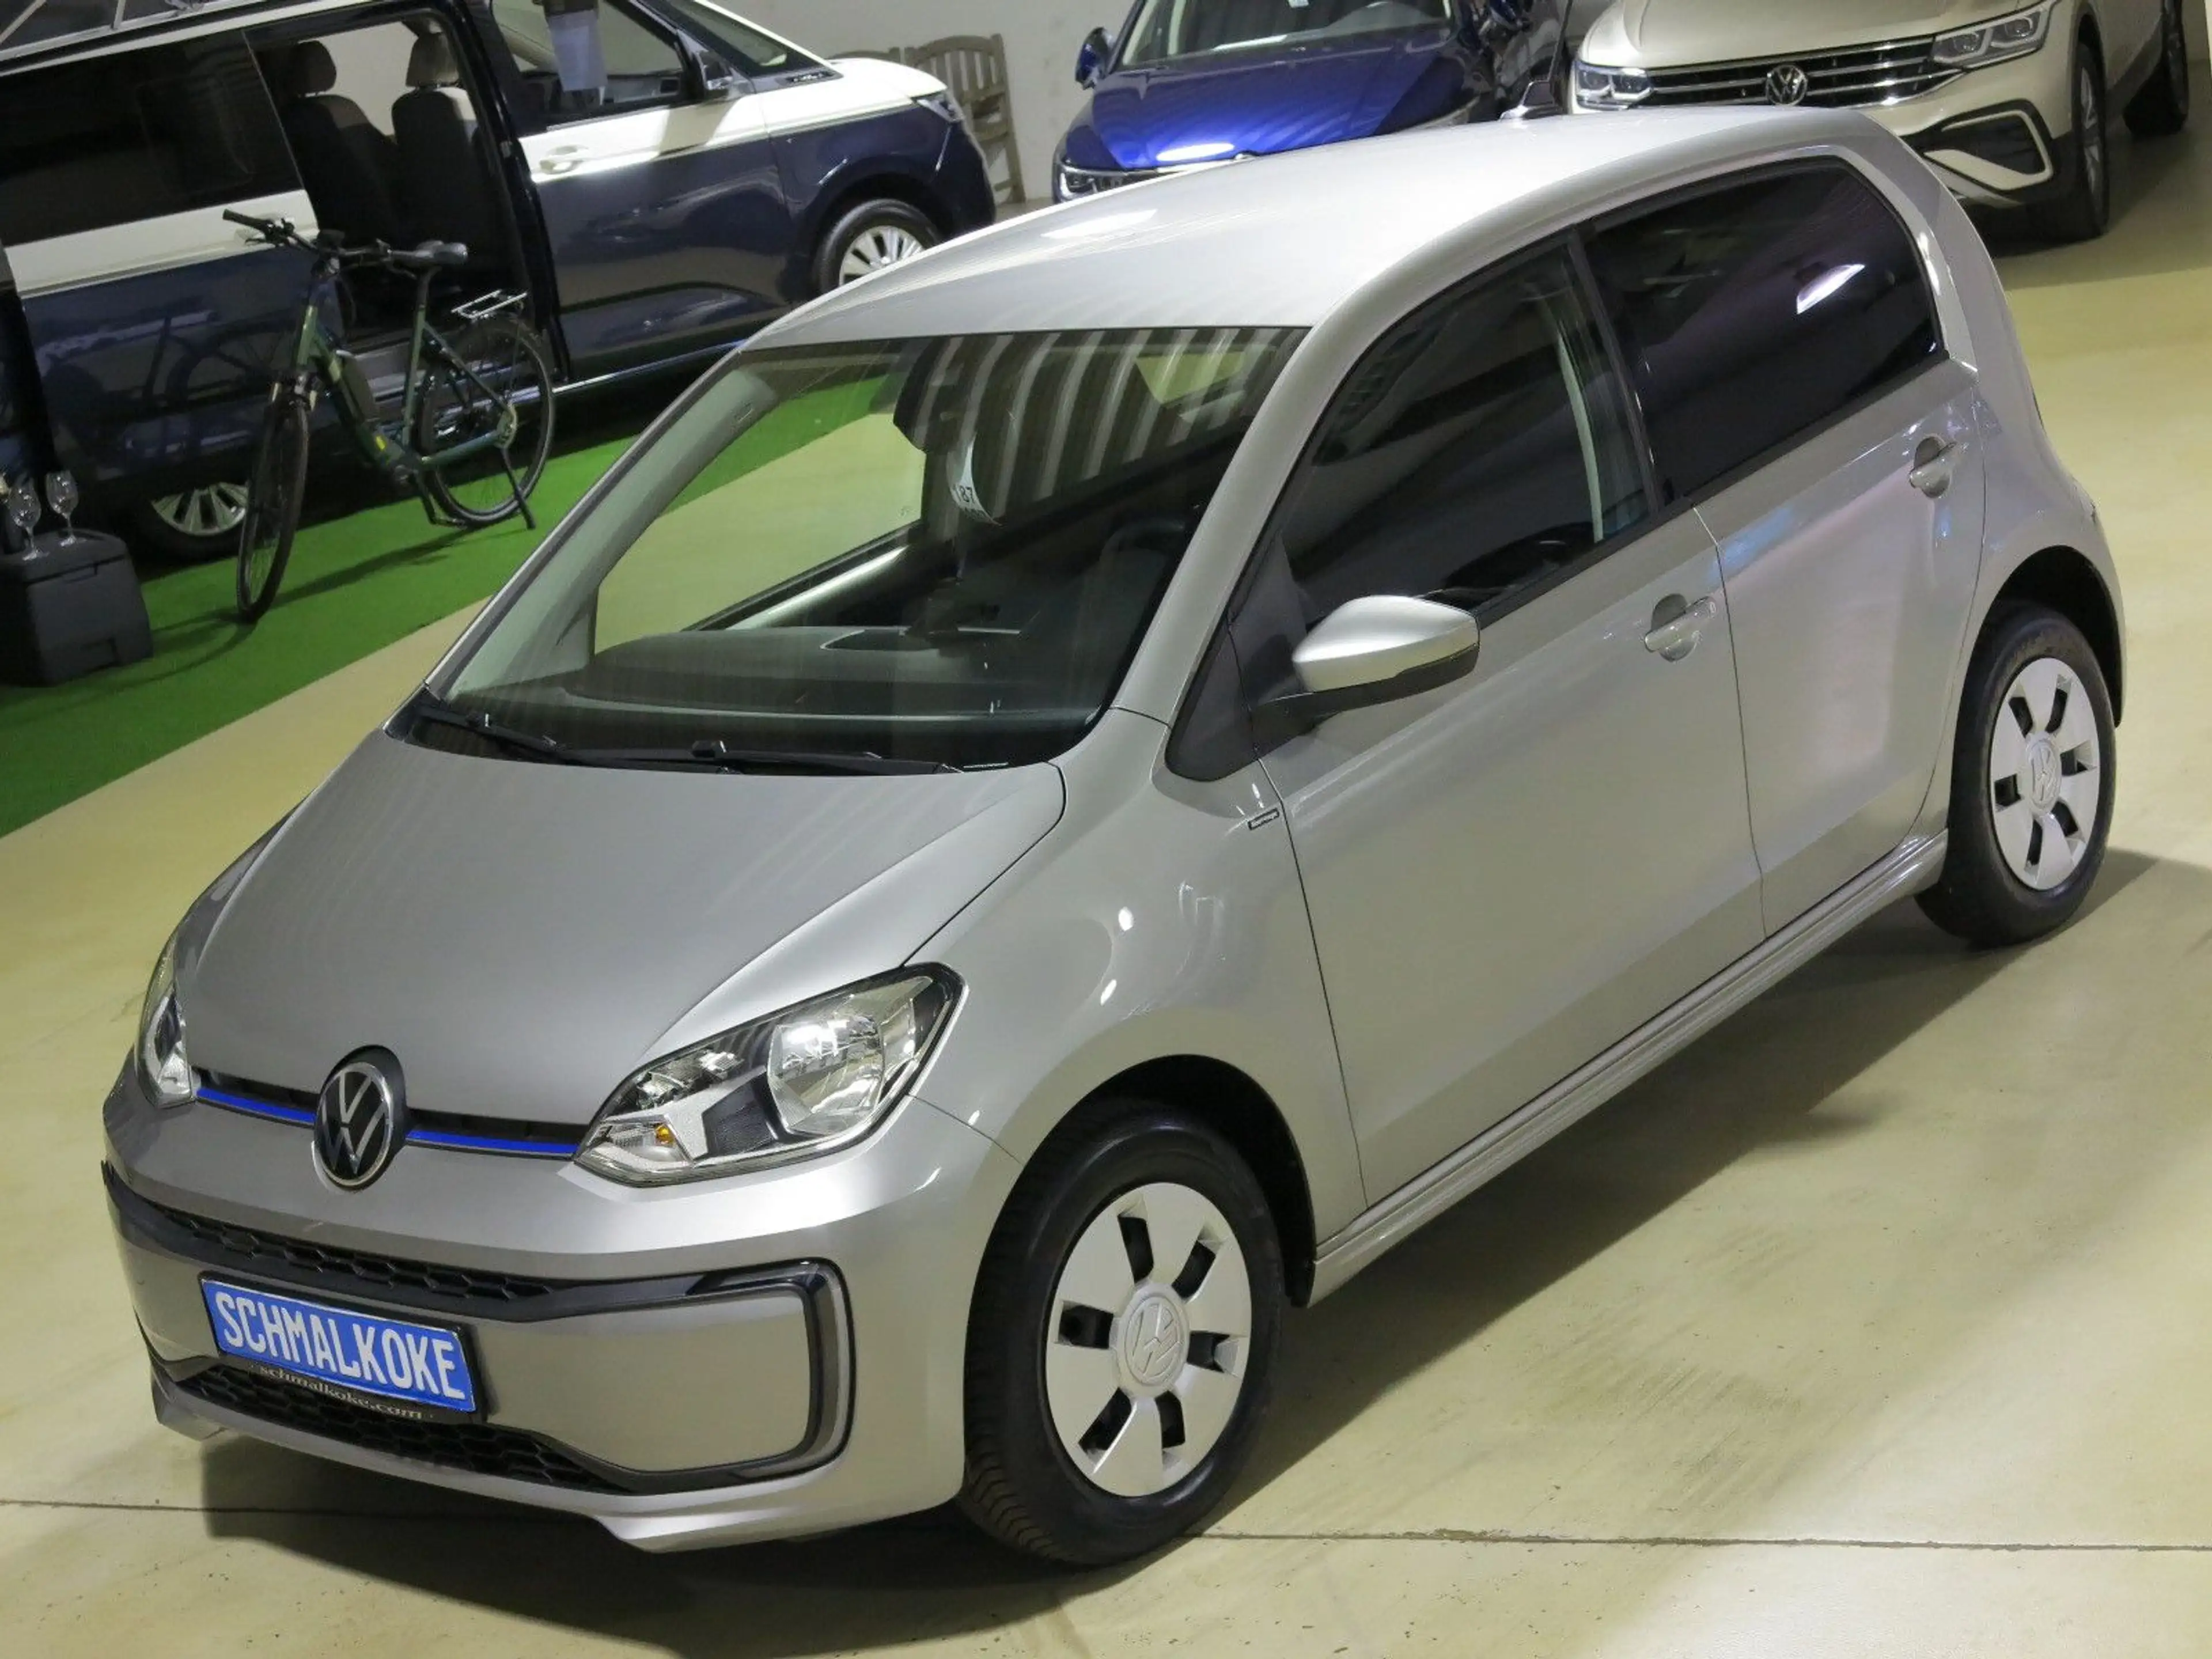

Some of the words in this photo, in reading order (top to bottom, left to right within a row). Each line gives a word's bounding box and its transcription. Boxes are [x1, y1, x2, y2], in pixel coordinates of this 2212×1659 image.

[1766, 65, 1807, 104] VW
[317, 1063, 393, 1185] VW
[215, 1291, 465, 1399] SCHMALKOKE
[1126, 1297, 1181, 1384] VW
[259, 1366, 422, 1419] schmalkoke.com
